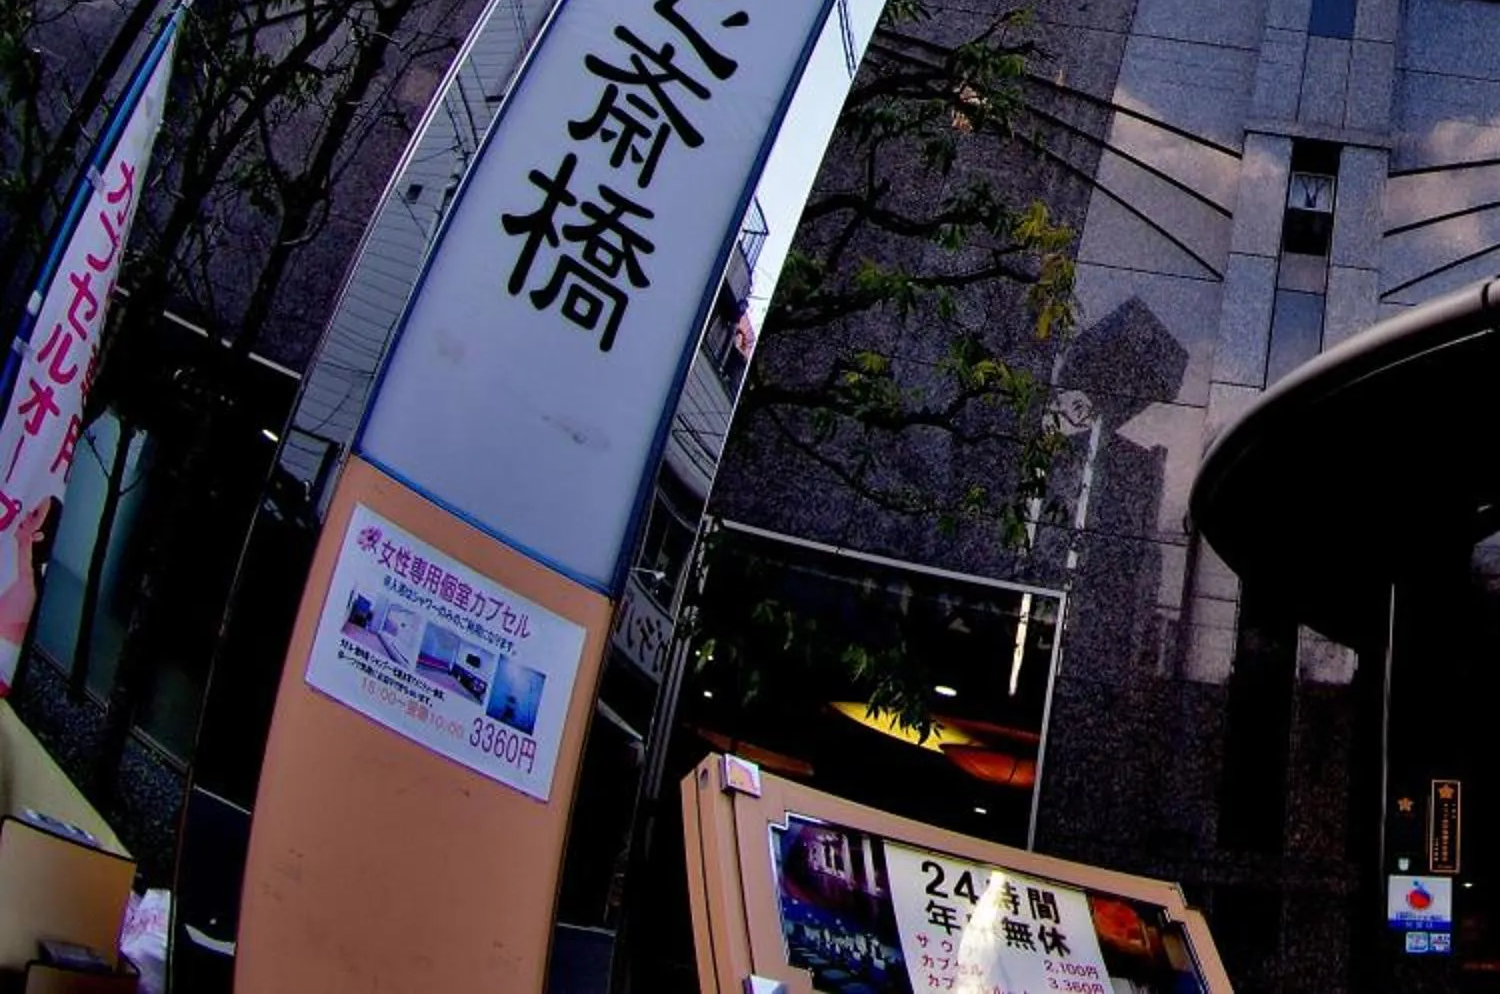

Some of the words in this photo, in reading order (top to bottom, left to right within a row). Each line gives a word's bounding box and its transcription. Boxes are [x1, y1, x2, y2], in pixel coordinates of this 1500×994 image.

[376, 539, 532, 641] 女性専用個室カプセル
[468, 716, 538, 775] 3360円
[924, 899, 1071, 958] 年無休
